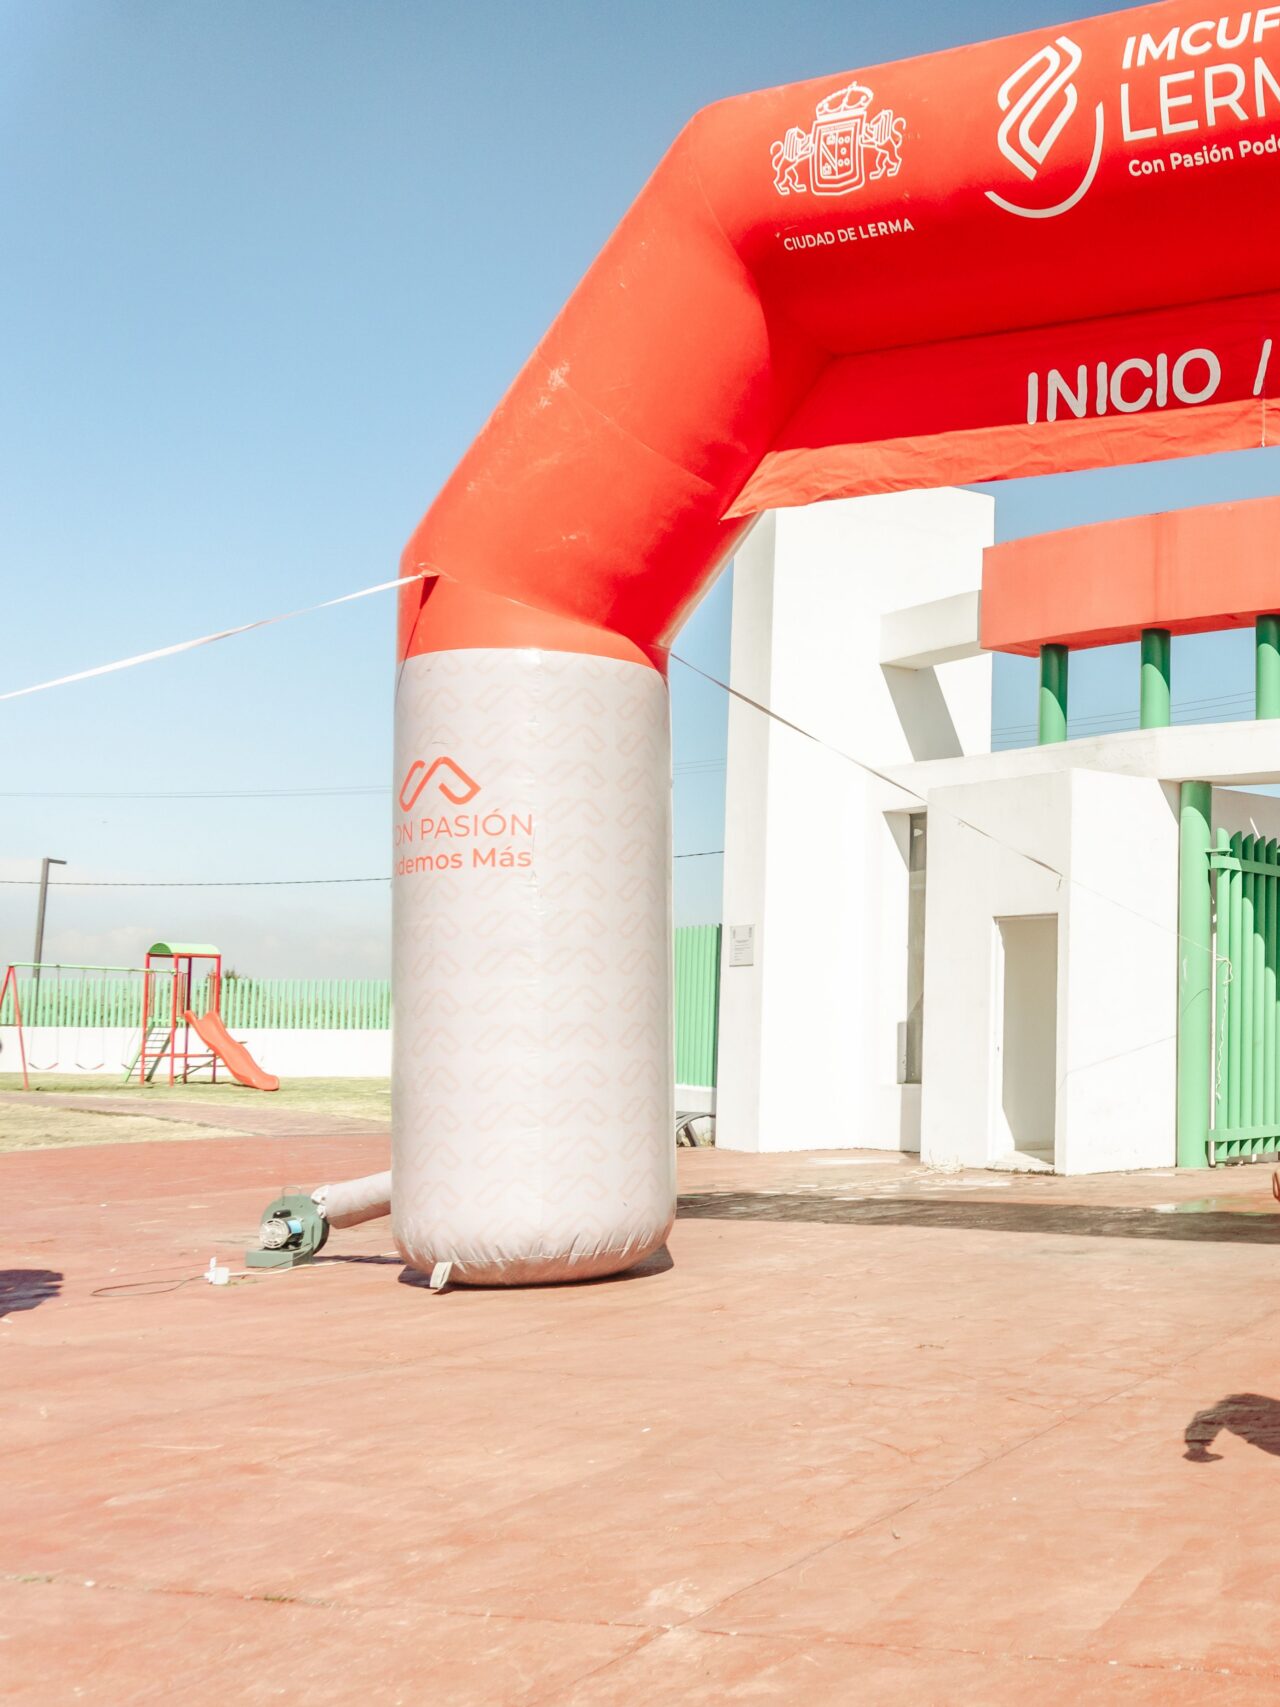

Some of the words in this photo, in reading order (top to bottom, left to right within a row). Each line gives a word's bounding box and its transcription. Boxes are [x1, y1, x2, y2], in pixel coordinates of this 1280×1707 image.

[1128, 159, 1165, 177] Con
[1170, 144, 1234, 170] Pasión
[783, 231, 835, 251] CIUDAD
[837, 227, 857, 243] DE
[859, 218, 914, 239] LERMA
[1027, 348, 1221, 425] INICIO
[421, 808, 532, 840] PASIÓN
[473, 846, 532, 869] Más
